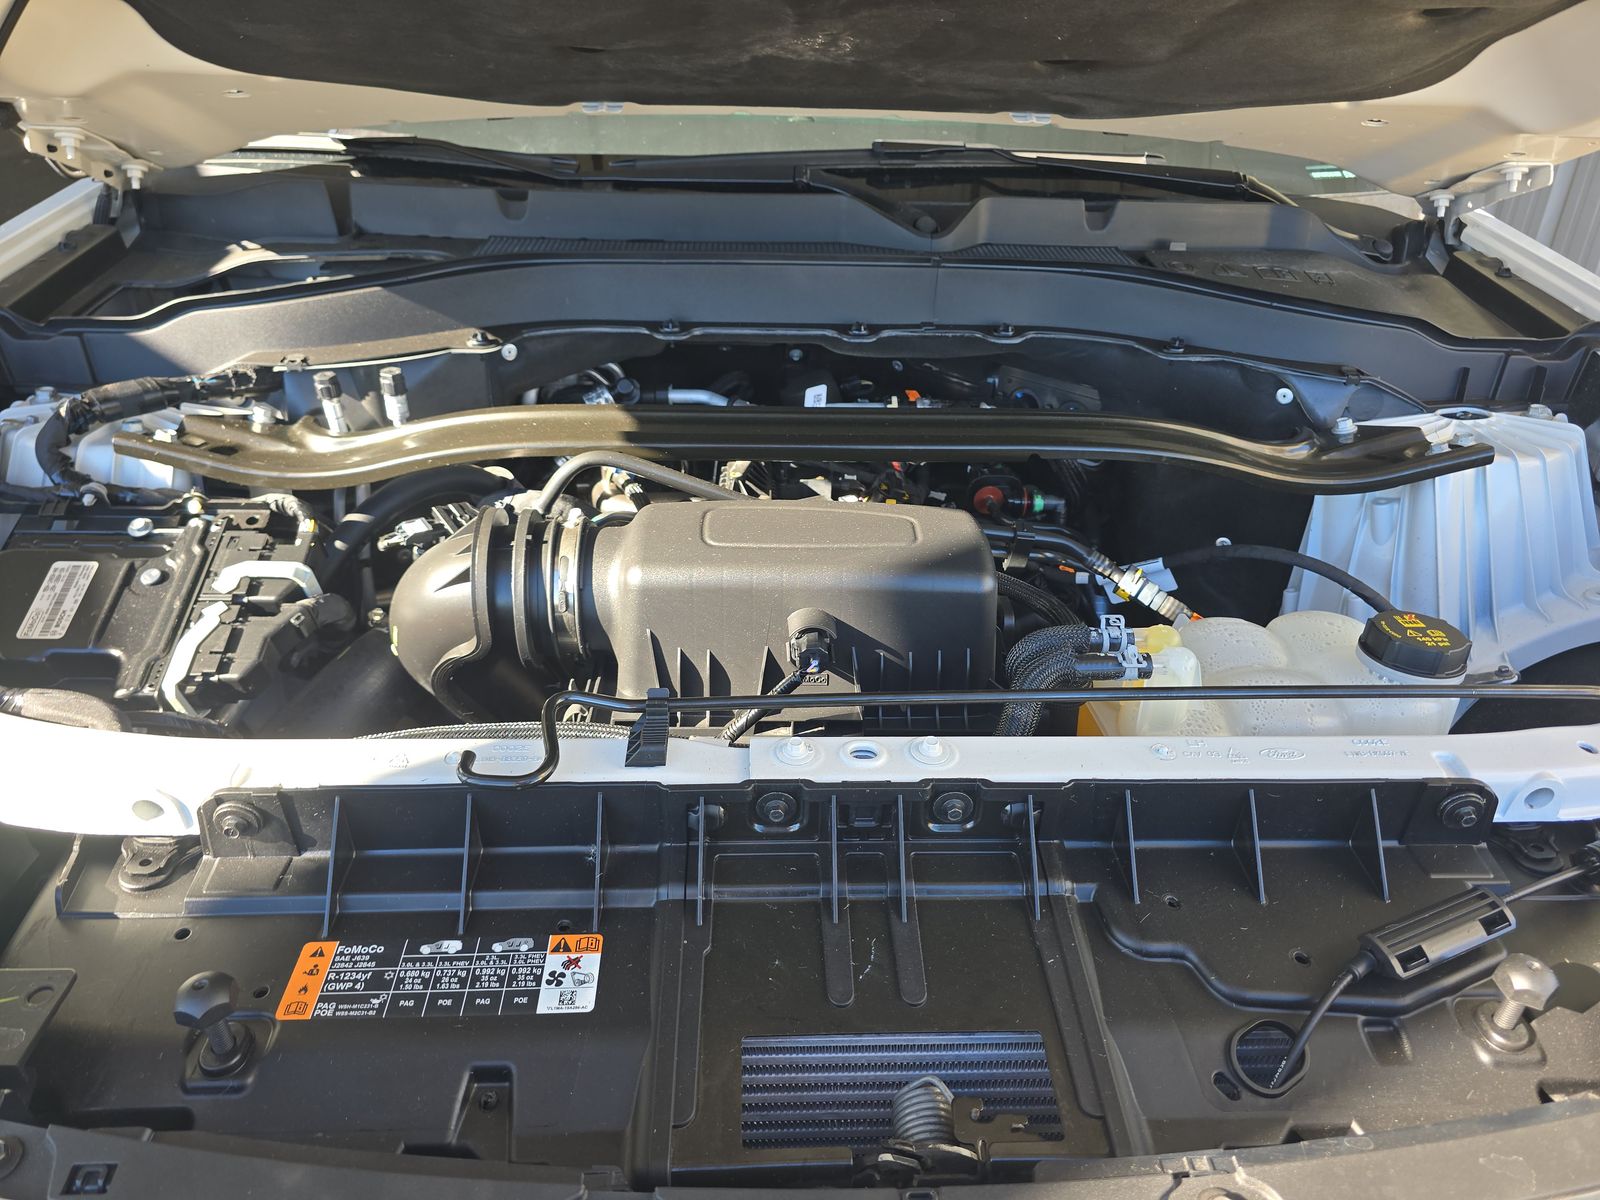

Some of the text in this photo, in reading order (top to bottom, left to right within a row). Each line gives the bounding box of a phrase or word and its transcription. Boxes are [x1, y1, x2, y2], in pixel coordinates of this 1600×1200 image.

[337, 945, 384, 954] FoMoCo
[421, 970, 430, 978] kg
[457, 969, 467, 977] kg
[496, 968, 506, 976] kg
[328, 972, 372, 981] R-1234yf
[324, 982, 365, 992] (GWP 4)
